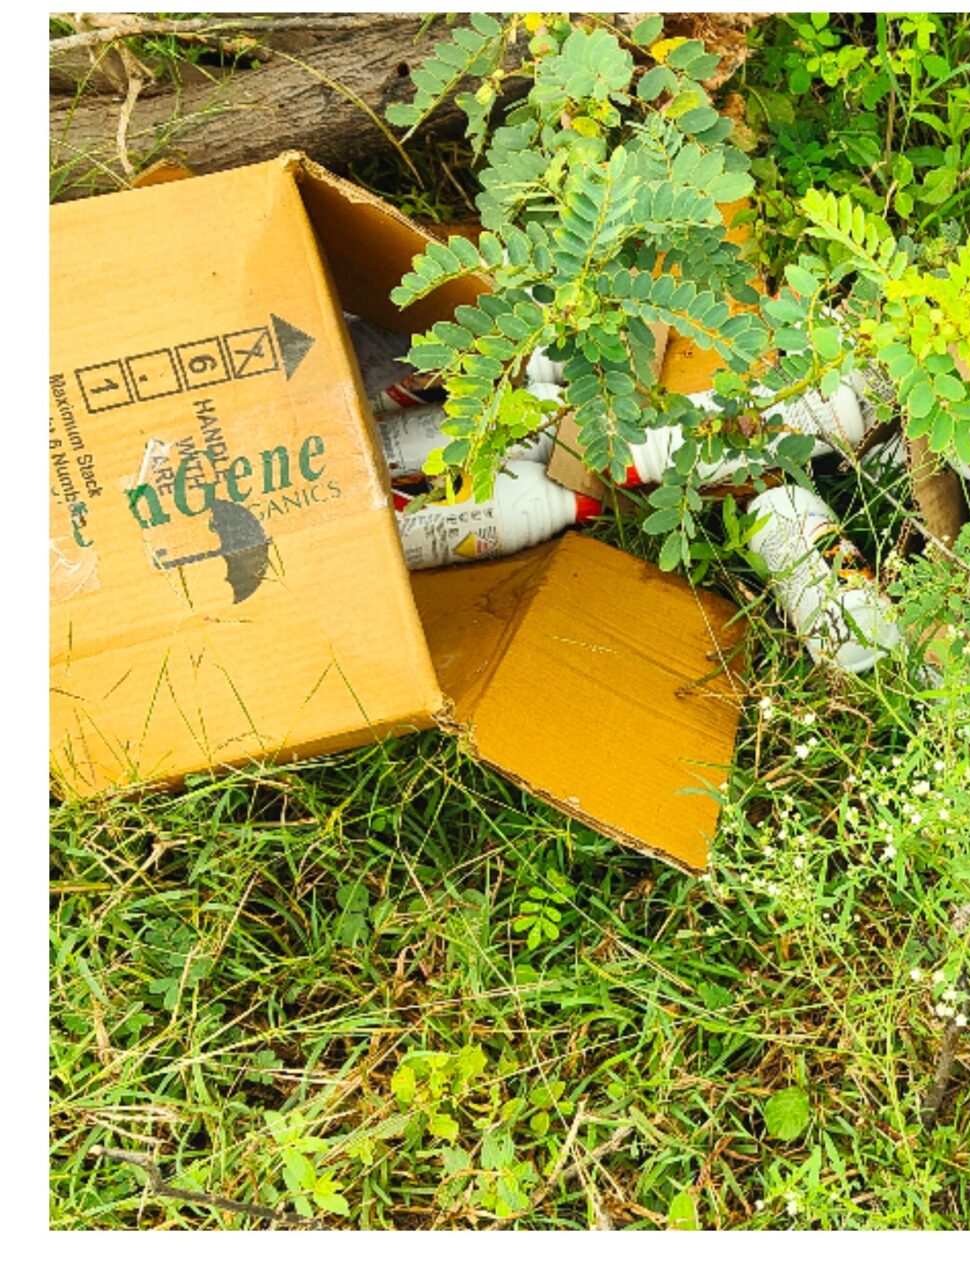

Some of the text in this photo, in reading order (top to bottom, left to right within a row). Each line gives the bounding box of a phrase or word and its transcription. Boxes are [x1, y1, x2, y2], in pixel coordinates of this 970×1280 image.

[90, 377, 120, 394] 1
[188, 353, 218, 374] 6
[50, 374, 103, 499] Maximum Stack
[175, 435, 204, 490] WITH
[193, 399, 230, 484] HANDLE
